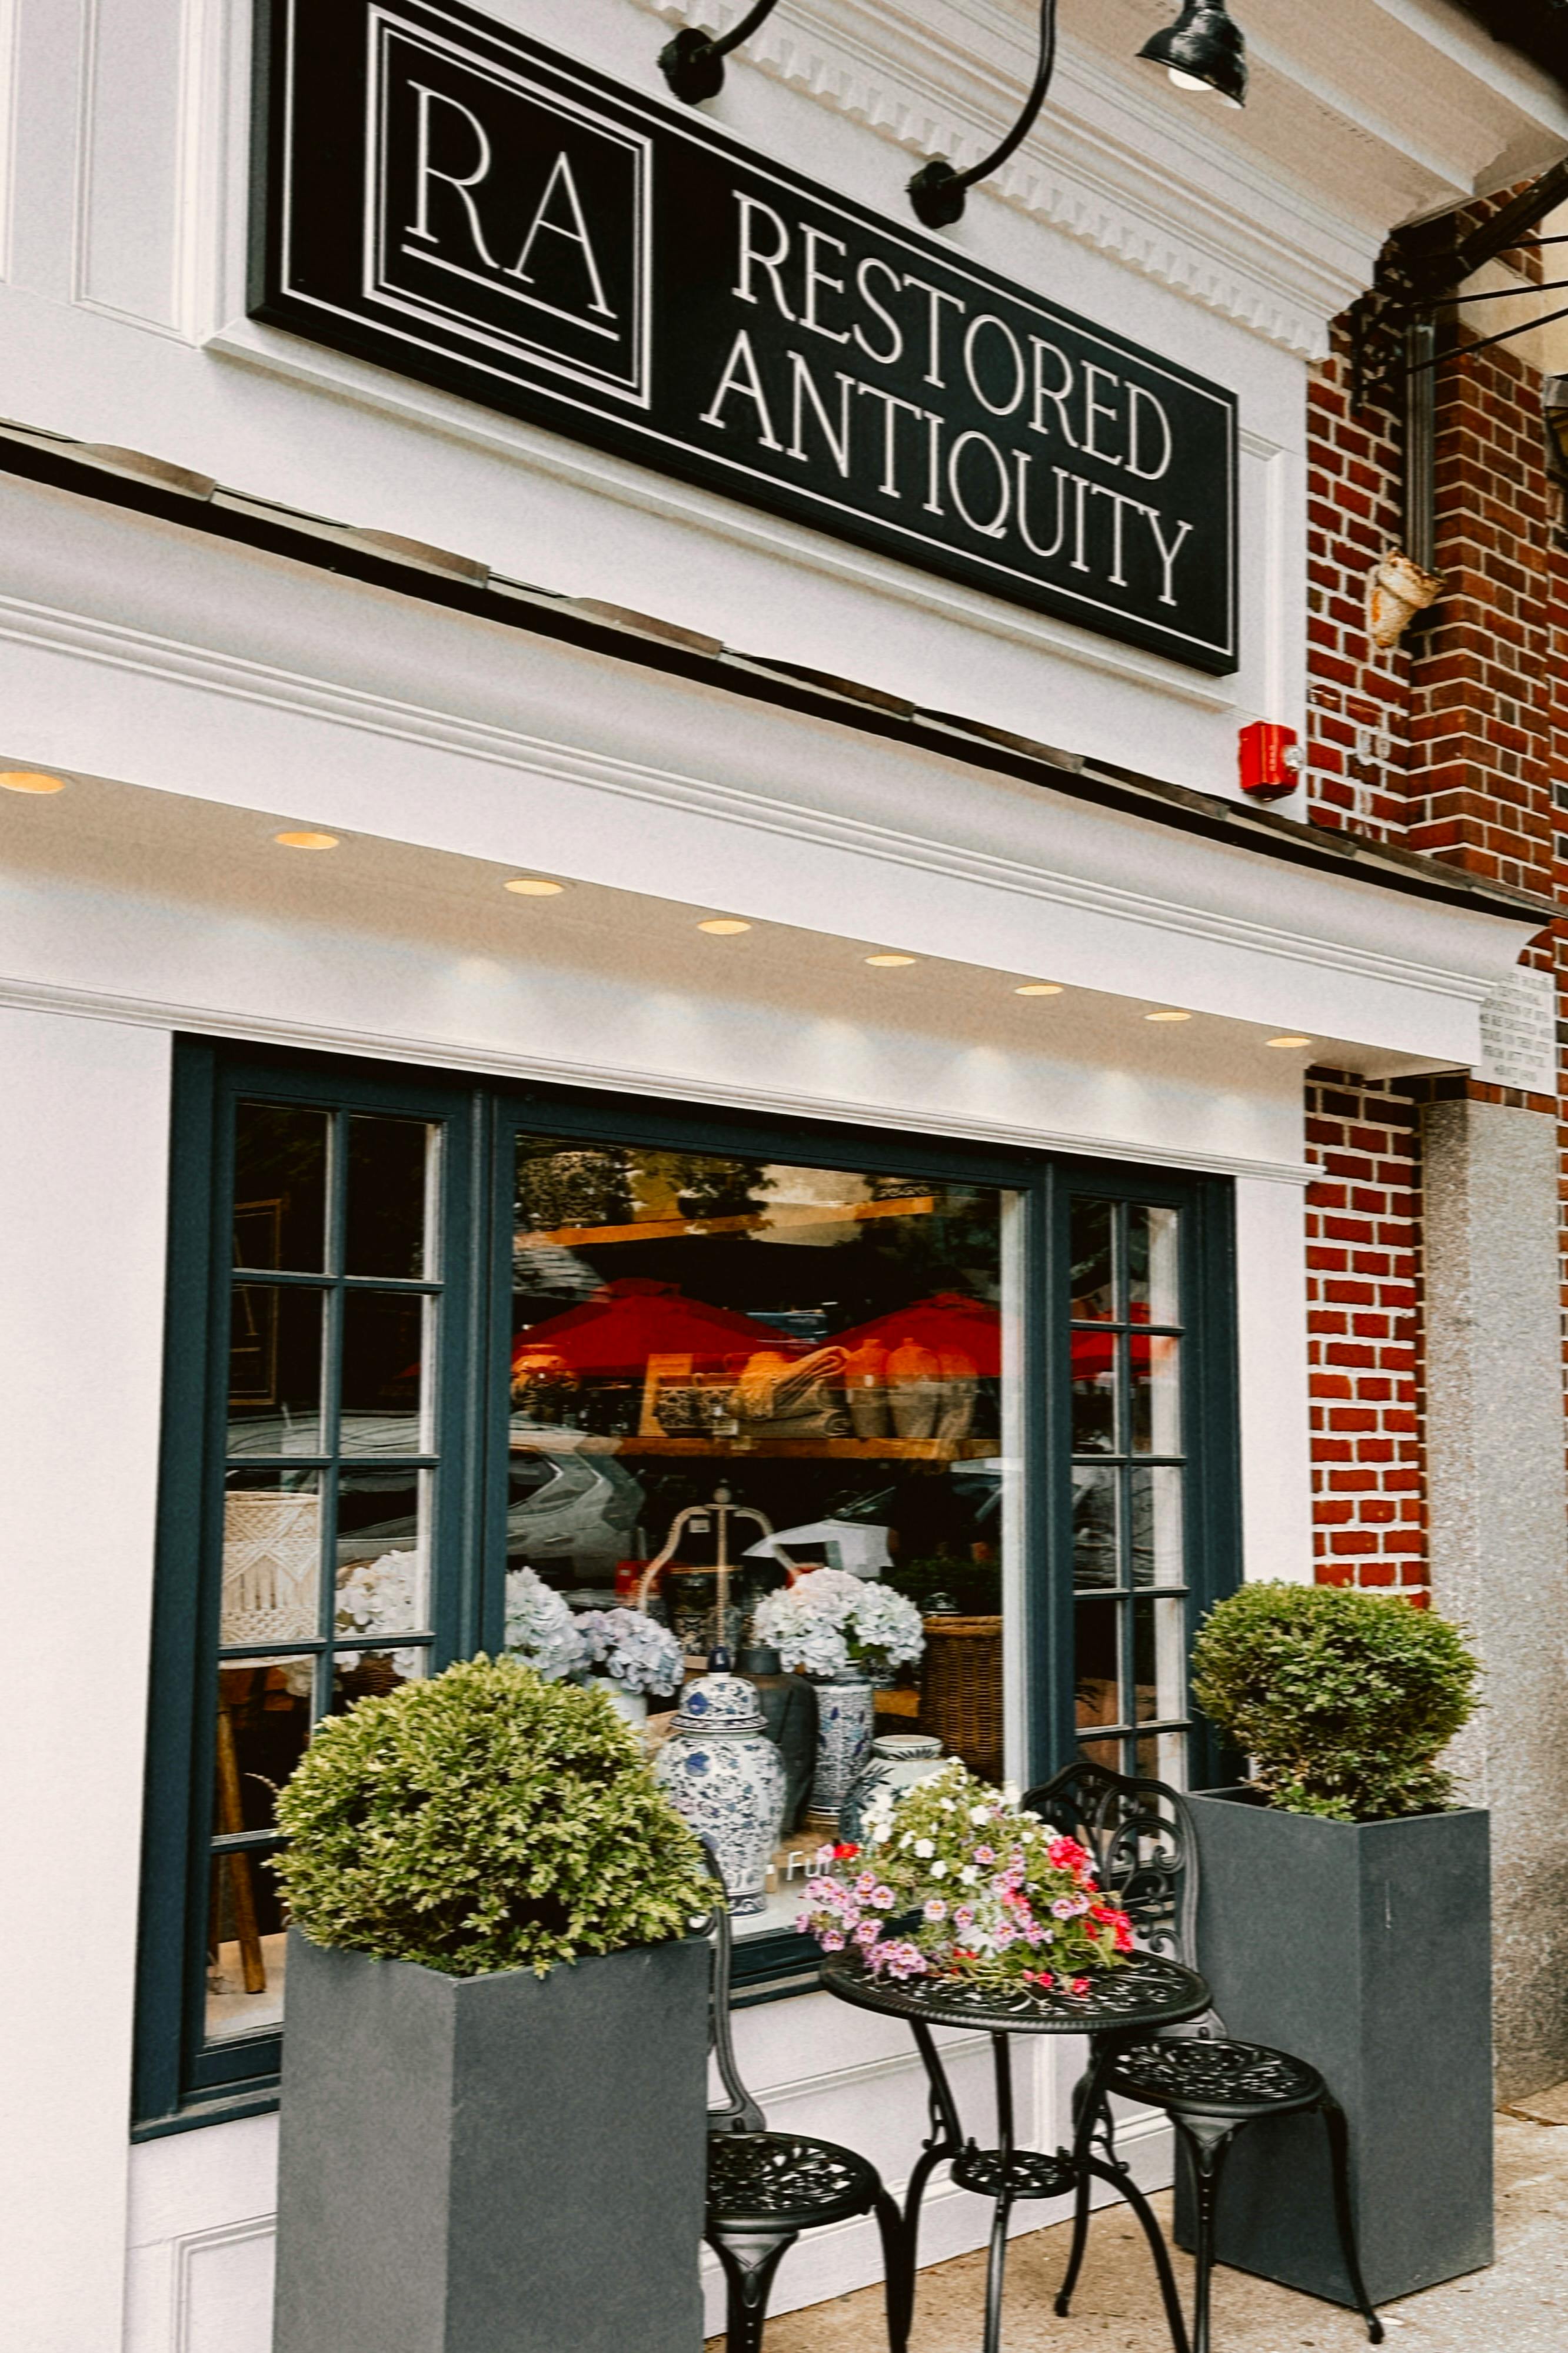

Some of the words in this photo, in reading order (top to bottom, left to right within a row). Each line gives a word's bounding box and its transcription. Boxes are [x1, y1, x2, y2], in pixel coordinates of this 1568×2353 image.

[405, 79, 618, 320] RA
[732, 189, 1172, 481] RESTORED
[699, 328, 1194, 607] ANTIQUITY
